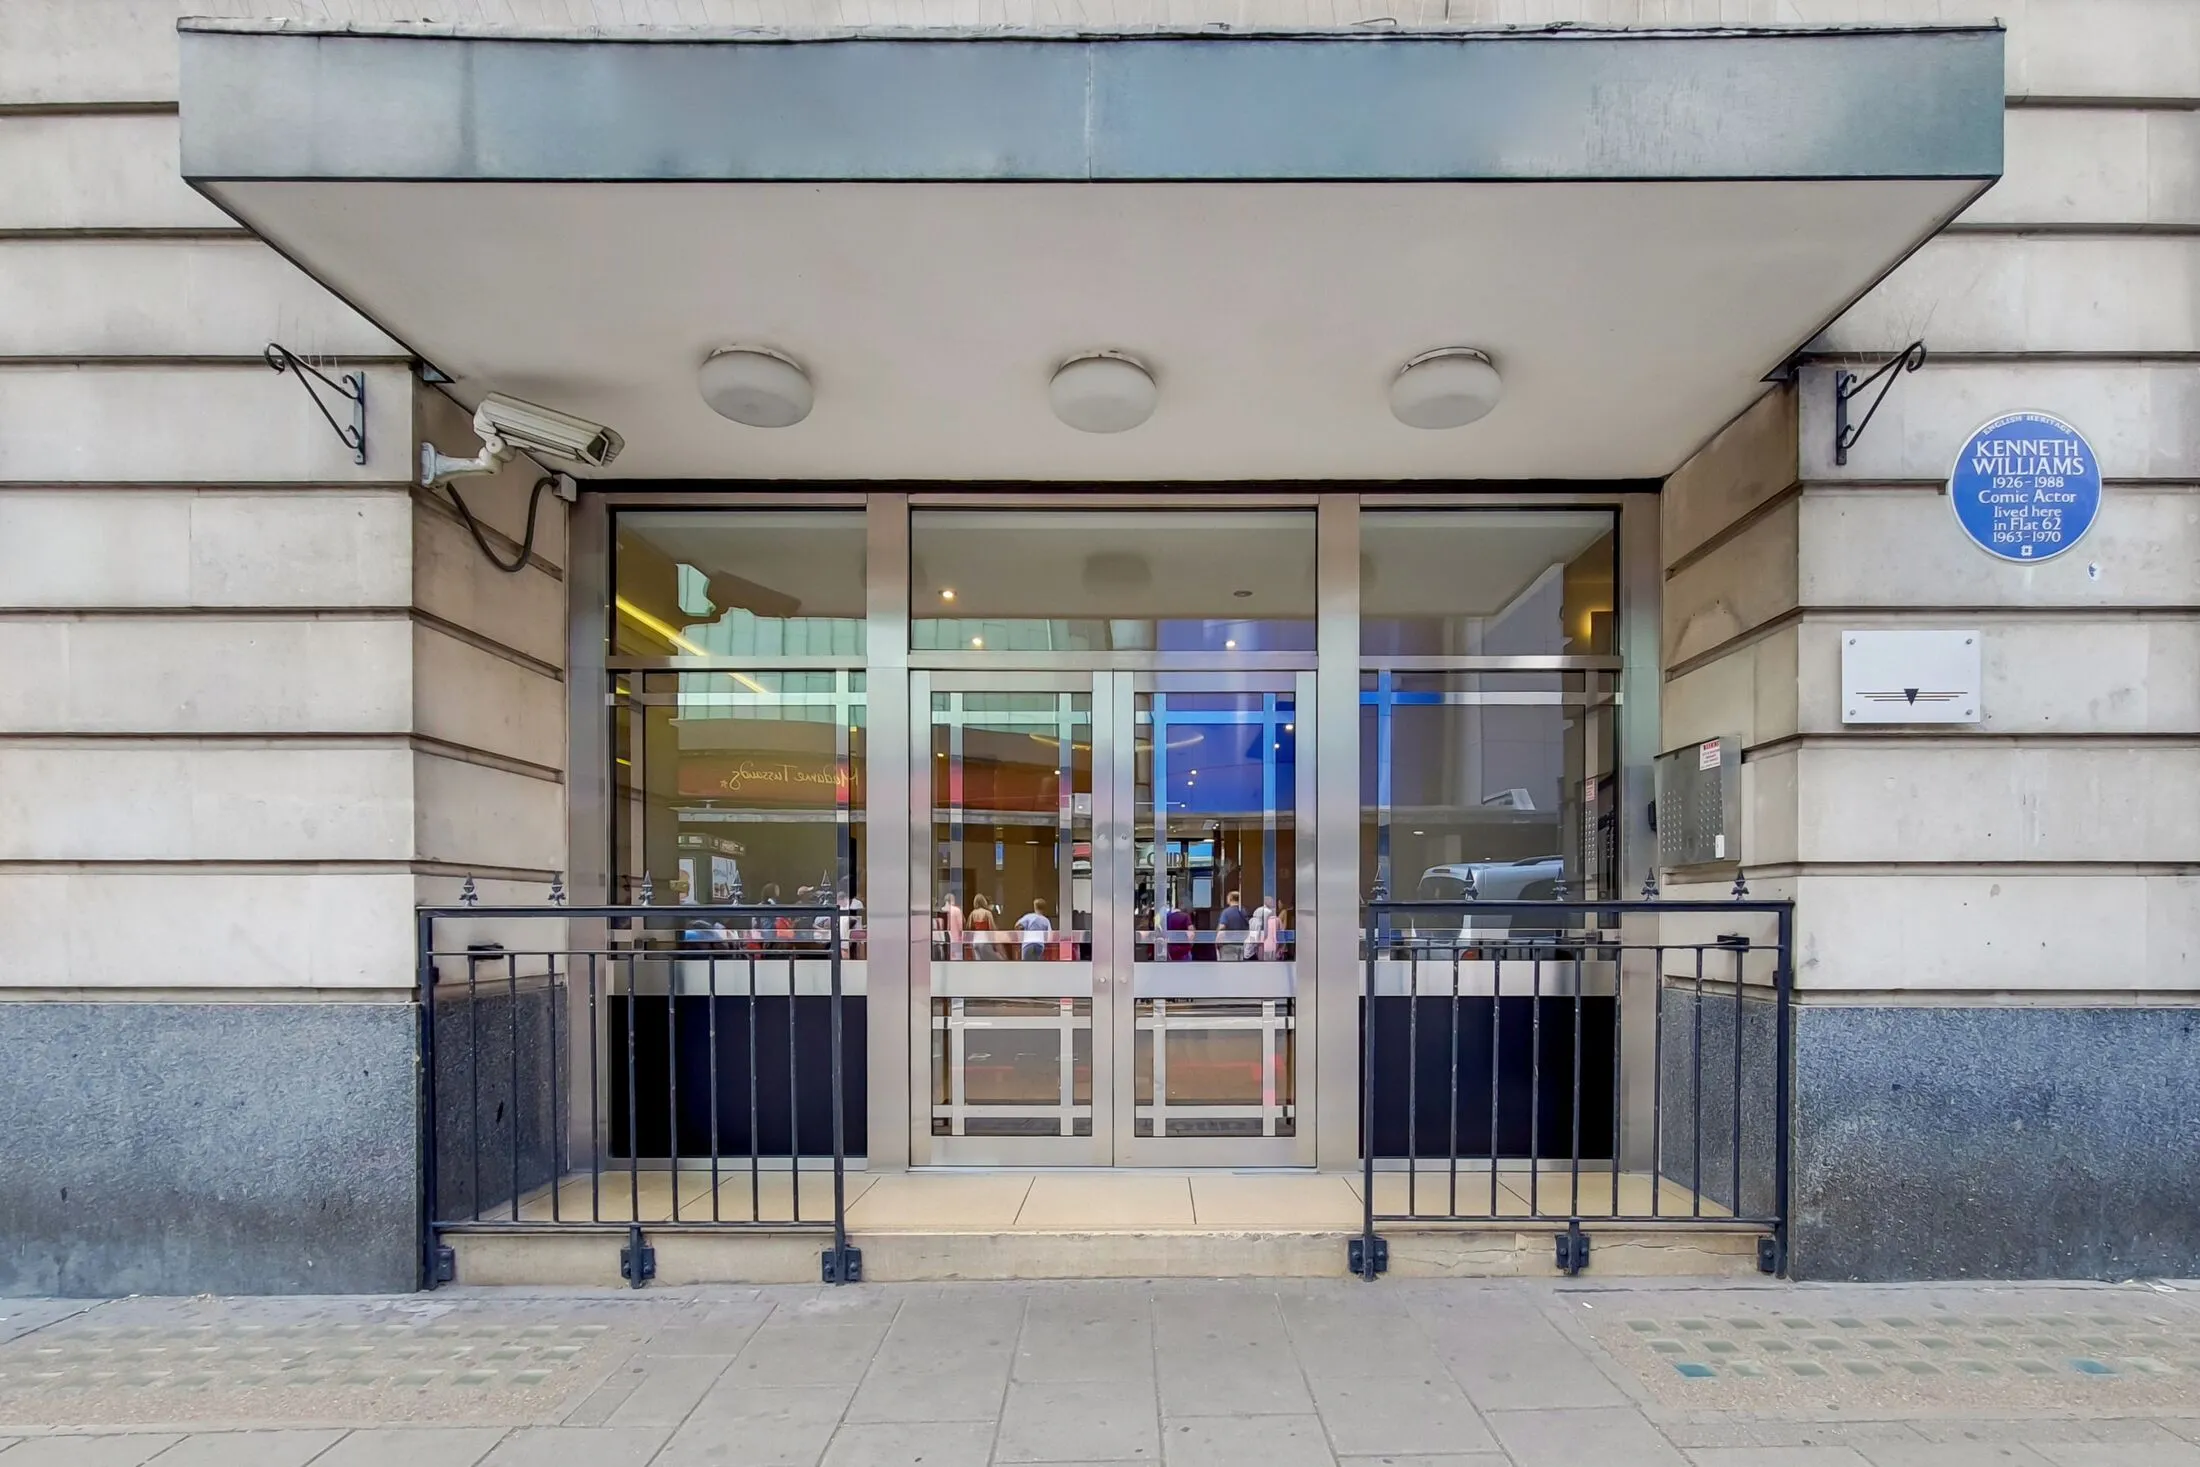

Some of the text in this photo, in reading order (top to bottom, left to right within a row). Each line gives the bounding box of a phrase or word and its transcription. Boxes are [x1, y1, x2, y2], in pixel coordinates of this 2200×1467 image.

[1983, 415, 2073, 436] ENGLISH HERITAGE
[1976, 439, 2079, 457] KENNETH
[1972, 457, 2085, 476] WILLIAMS
[1978, 488, 2077, 504] Comic Actor
[1994, 505, 2062, 518] lived here
[1993, 517, 2062, 531] in Flat 62
